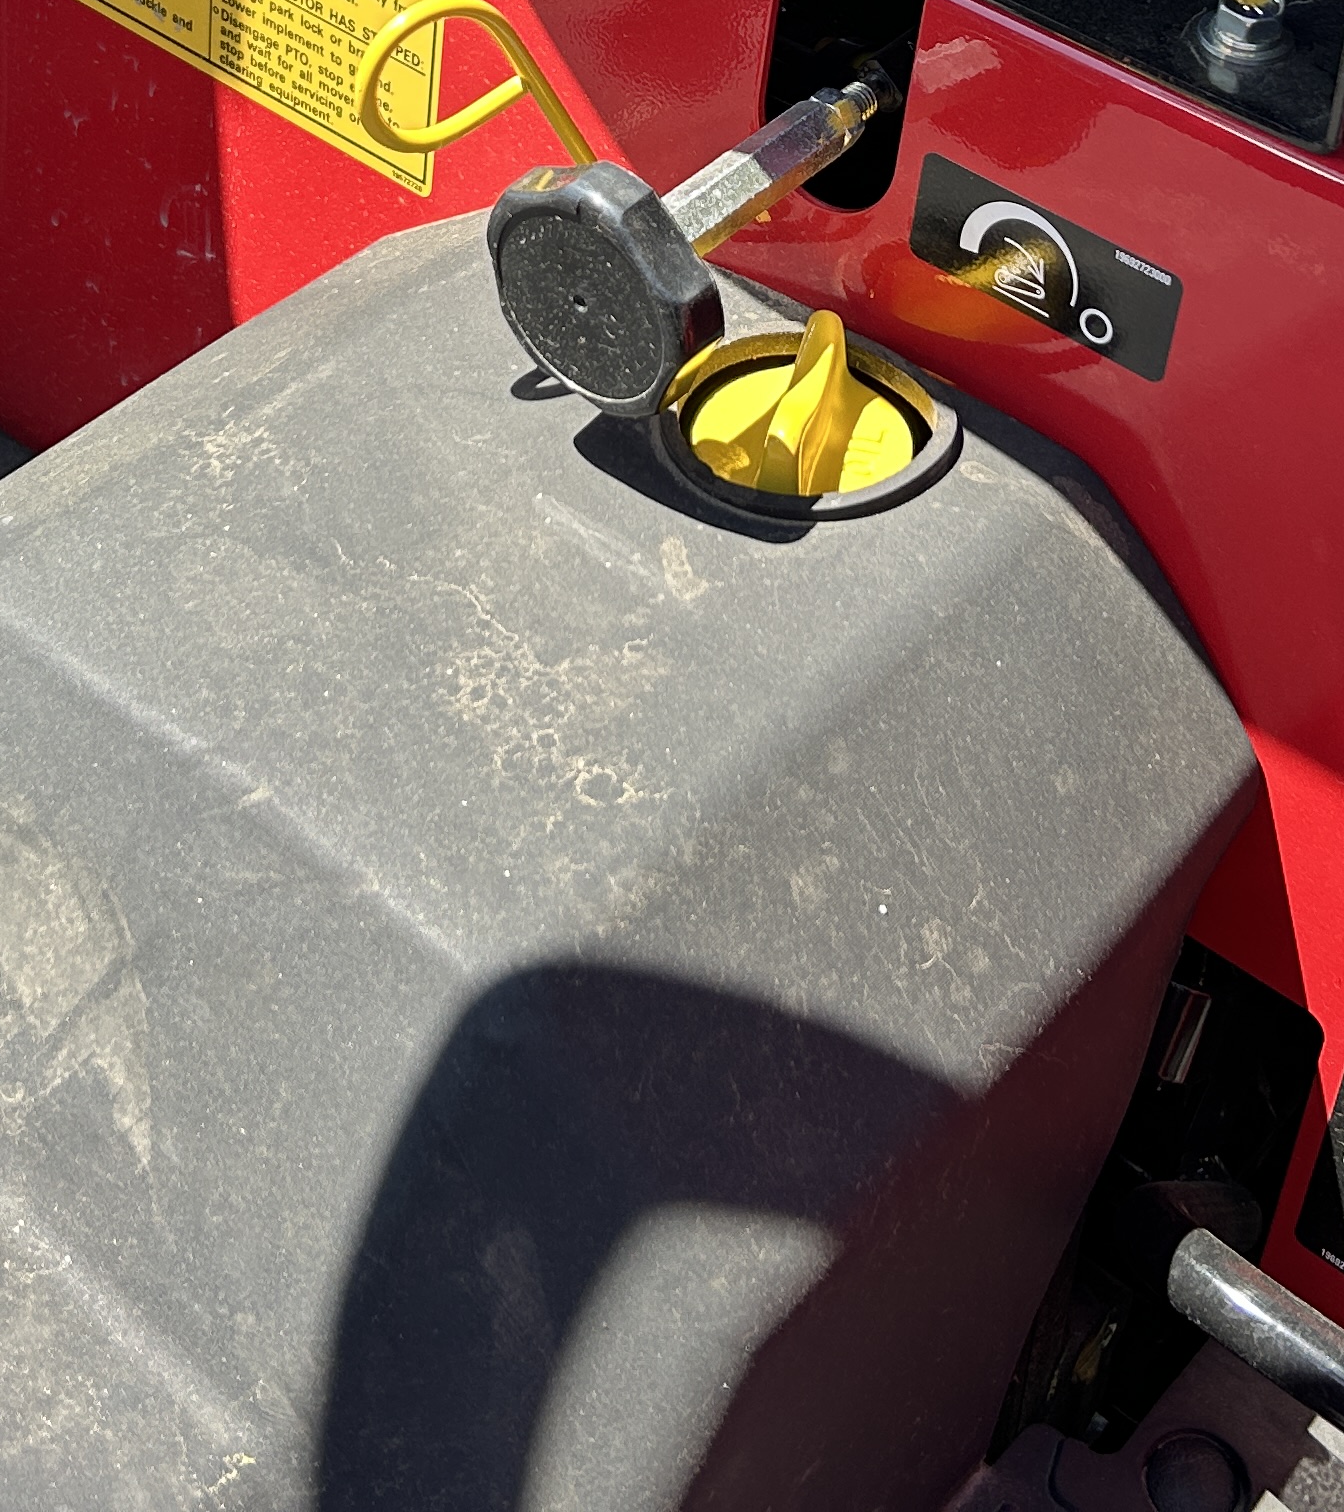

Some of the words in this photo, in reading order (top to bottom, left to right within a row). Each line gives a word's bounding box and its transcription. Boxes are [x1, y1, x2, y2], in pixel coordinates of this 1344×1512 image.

[172, 13, 193, 33] and
[220, 7, 280, 51] Disengage
[285, 43, 312, 69] PTO,
[317, 65, 344, 87] stop
[262, 12, 325, 58] implement
[329, 51, 343, 67] to
[269, 0, 294, 22] park
[300, 13, 324, 38] lock
[329, 34, 343, 47] or
[329, 8, 356, 33] HAS
[219, 25, 242, 45] and
[277, 54, 294, 73] for
[299, 69, 313, 84] all
[219, 39, 245, 61] stop
[250, 53, 286, 84] before
[291, 80, 343, 118] servicing
[218, 54, 264, 88] clearing
[268, 82, 337, 125] equipment.
